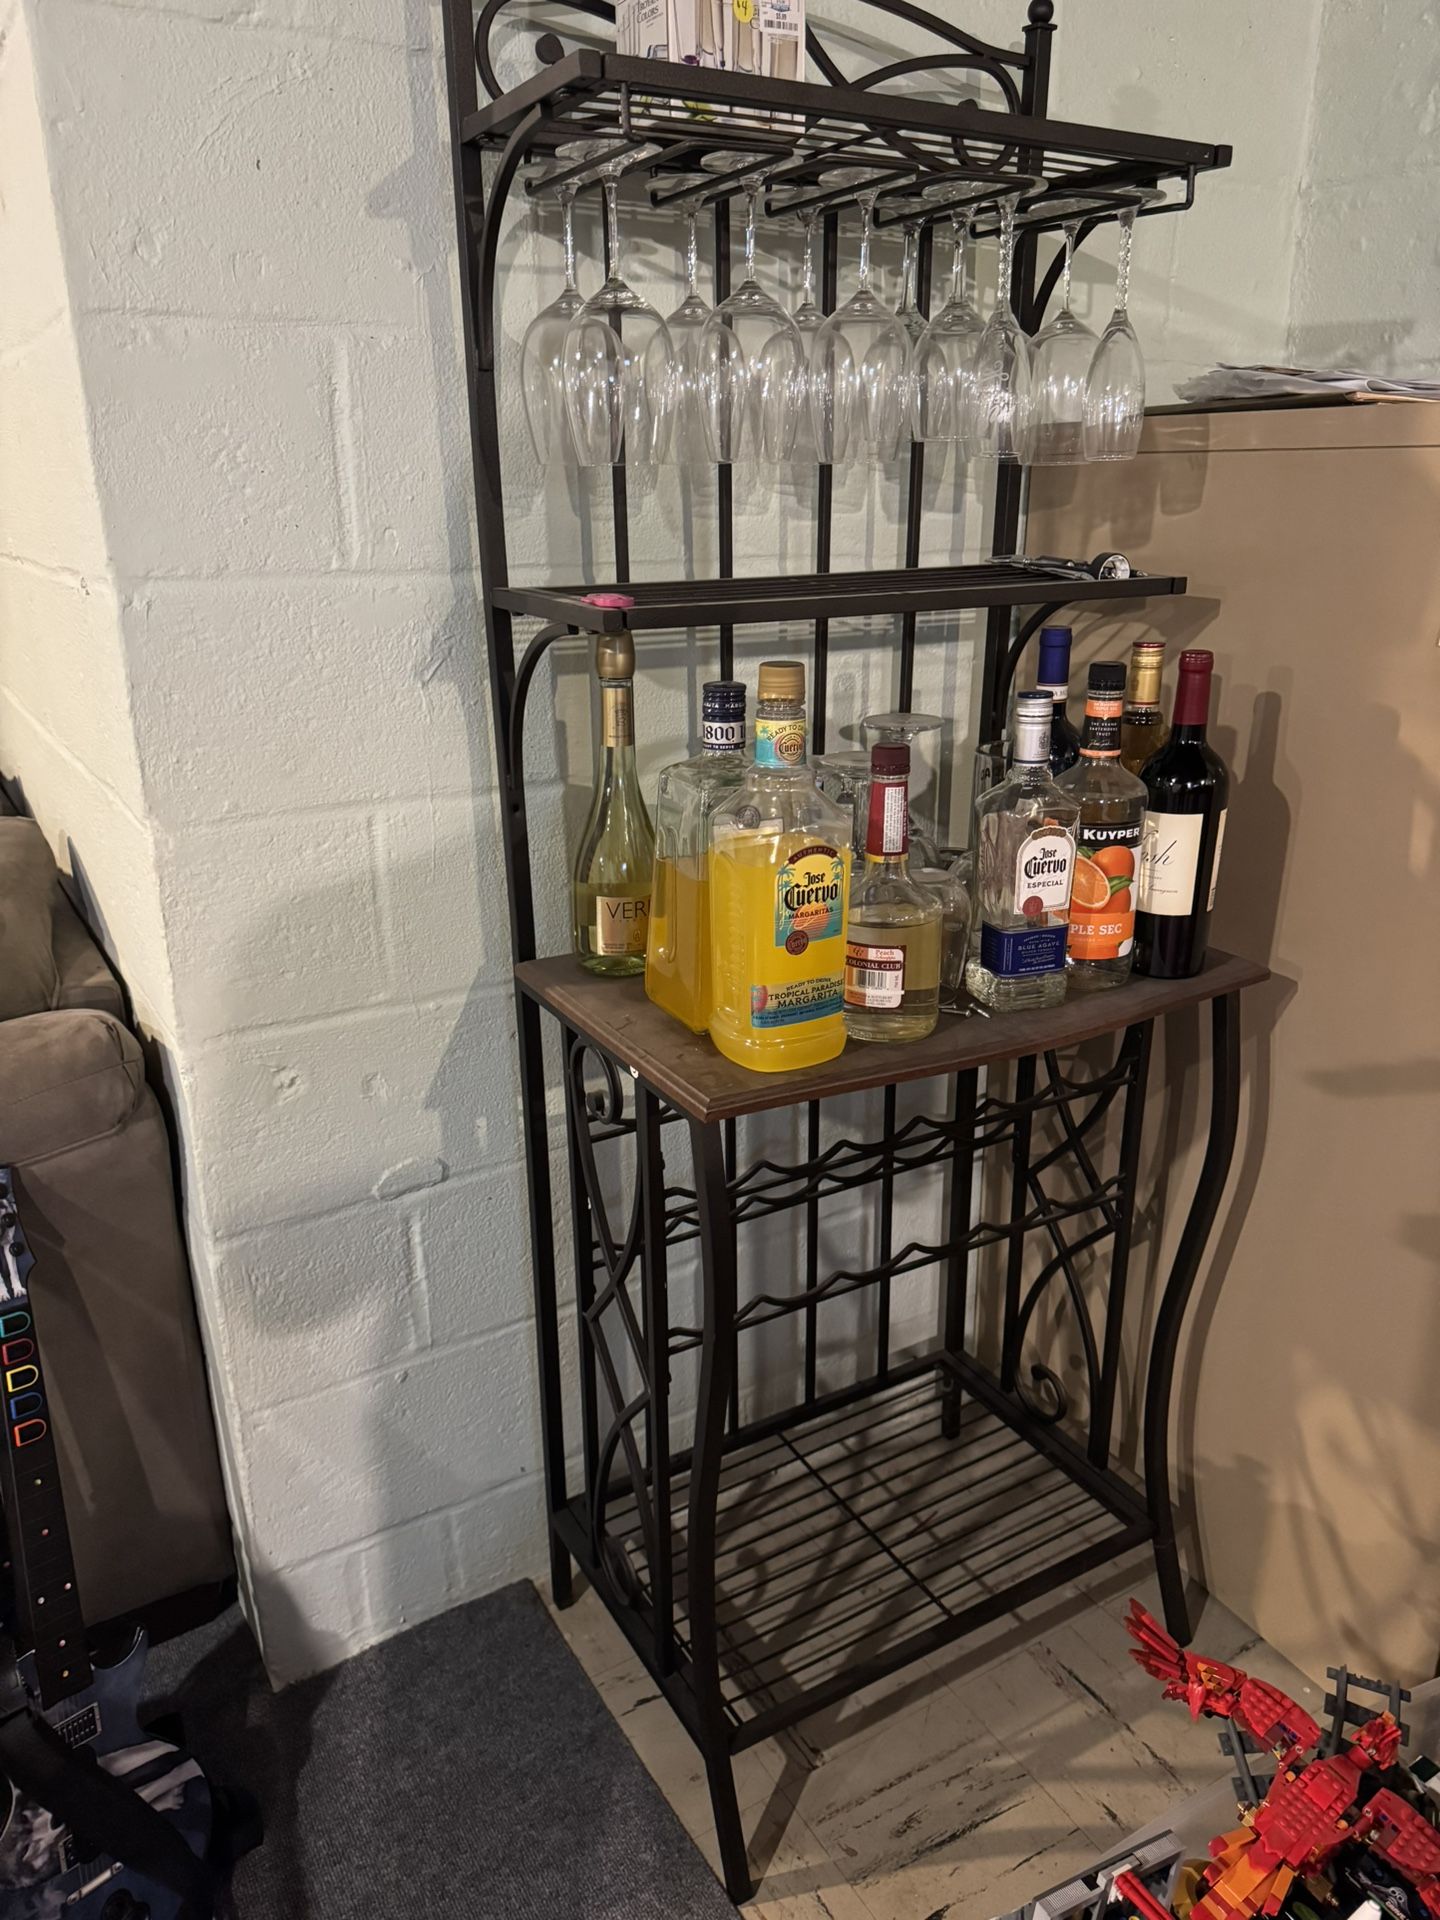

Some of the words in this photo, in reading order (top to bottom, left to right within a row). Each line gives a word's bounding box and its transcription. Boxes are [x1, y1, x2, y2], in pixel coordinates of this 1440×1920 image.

[767, 725, 787, 741] READY
[1083, 827, 1140, 841] KUYPER
[1040, 847, 1058, 860] Jose
[1024, 856, 1067, 879] Cuervo
[803, 871, 826, 888] Jose
[1027, 880, 1064, 889] ESPECIAL
[784, 882, 838, 912] Cuervo
[788, 906, 834, 921] MARGARITAS
[1098, 923, 1122, 935] SEC
[1038, 941, 1060, 949] AGAVE
[786, 981, 805, 991] READY
[768, 988, 810, 1001] TROPICAL
[777, 988, 838, 1008] MARGARITA
